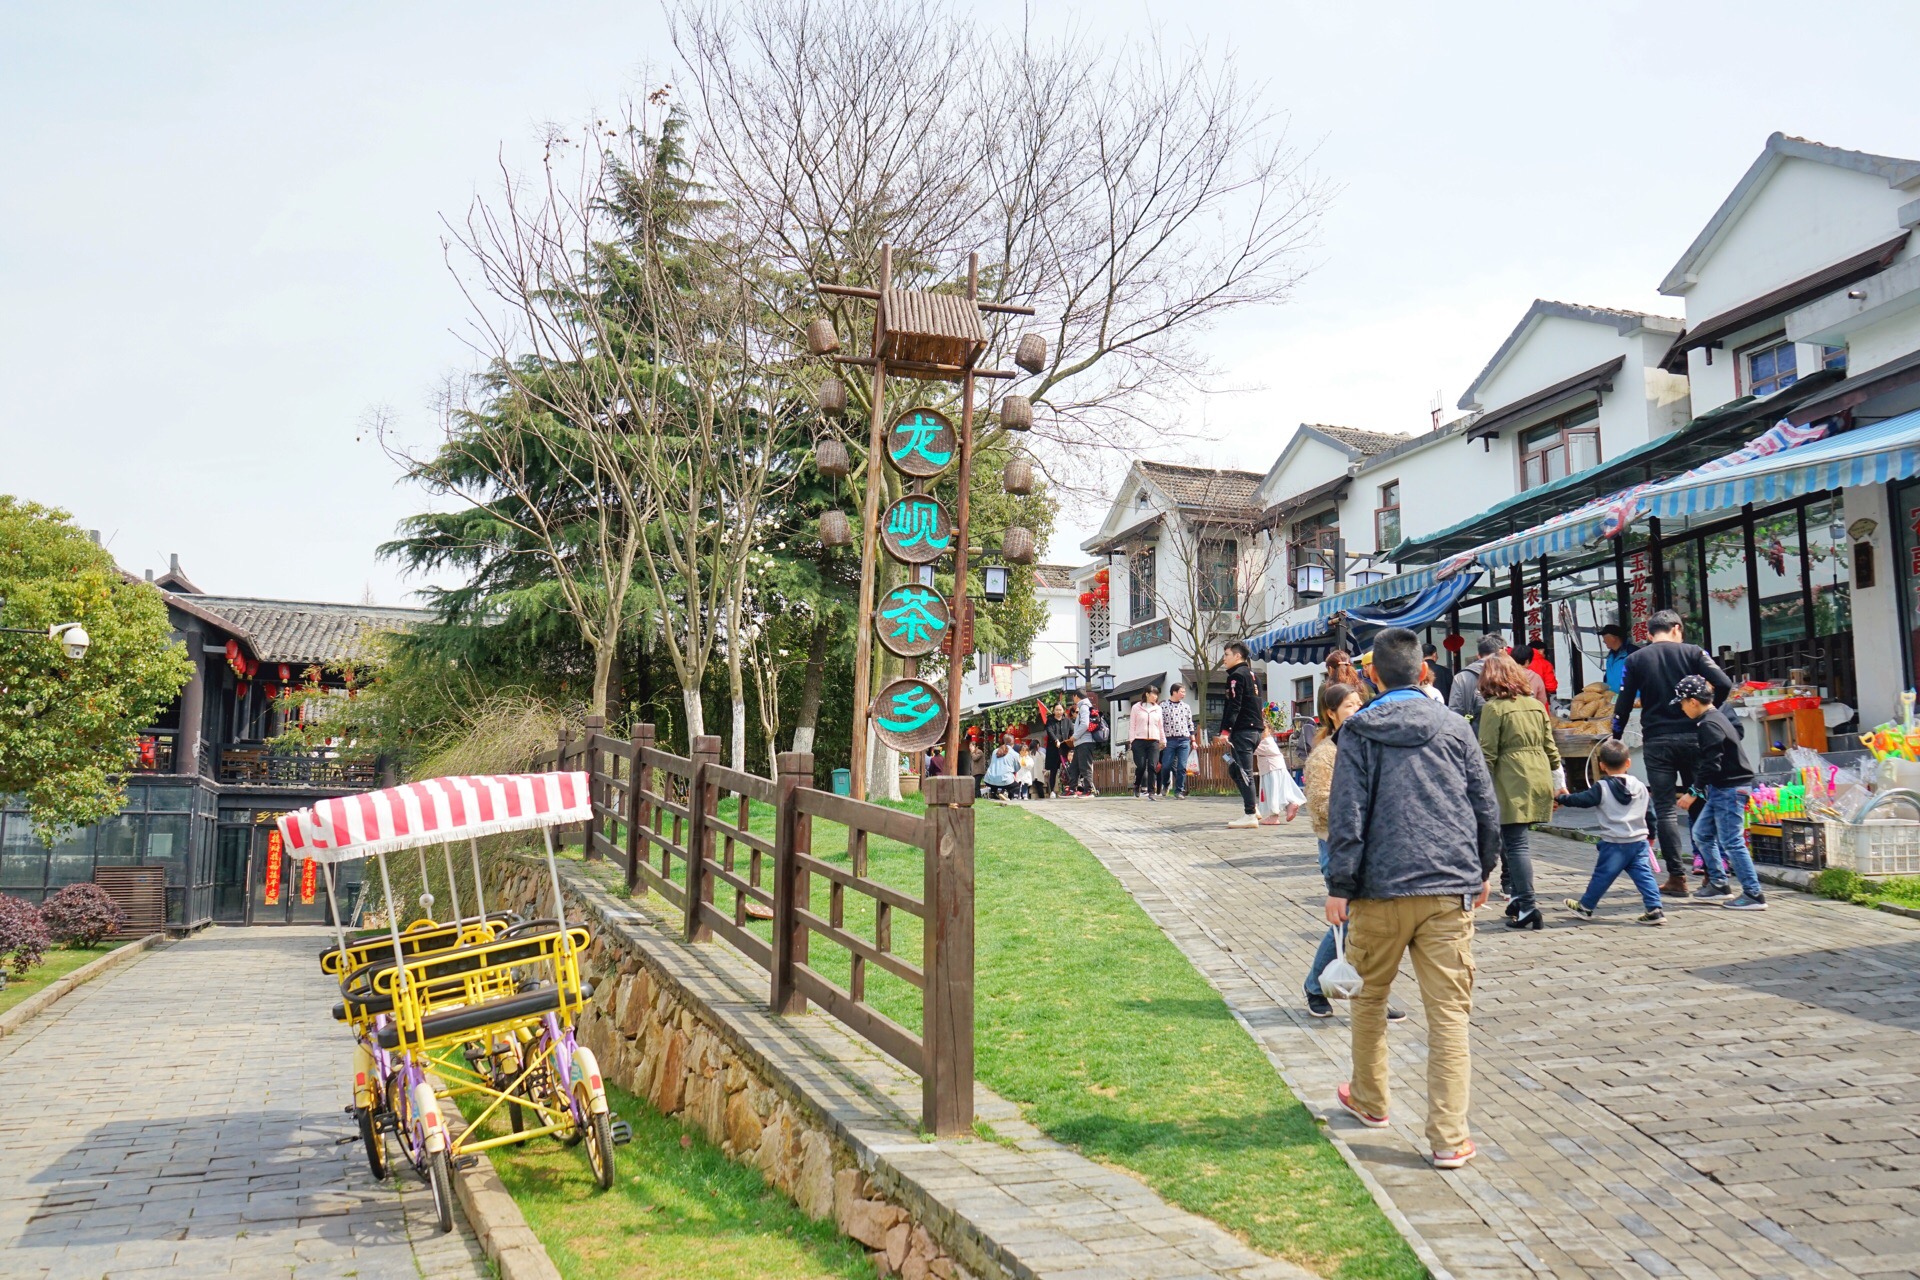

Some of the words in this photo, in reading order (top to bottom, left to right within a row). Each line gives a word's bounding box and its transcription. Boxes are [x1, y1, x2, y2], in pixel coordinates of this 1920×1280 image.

[878, 413, 951, 733] 龙岘茶乡
[1630, 553, 1647, 642] 玉龙茶餐
[305, 857, 315, 896] 喜迎富贵
